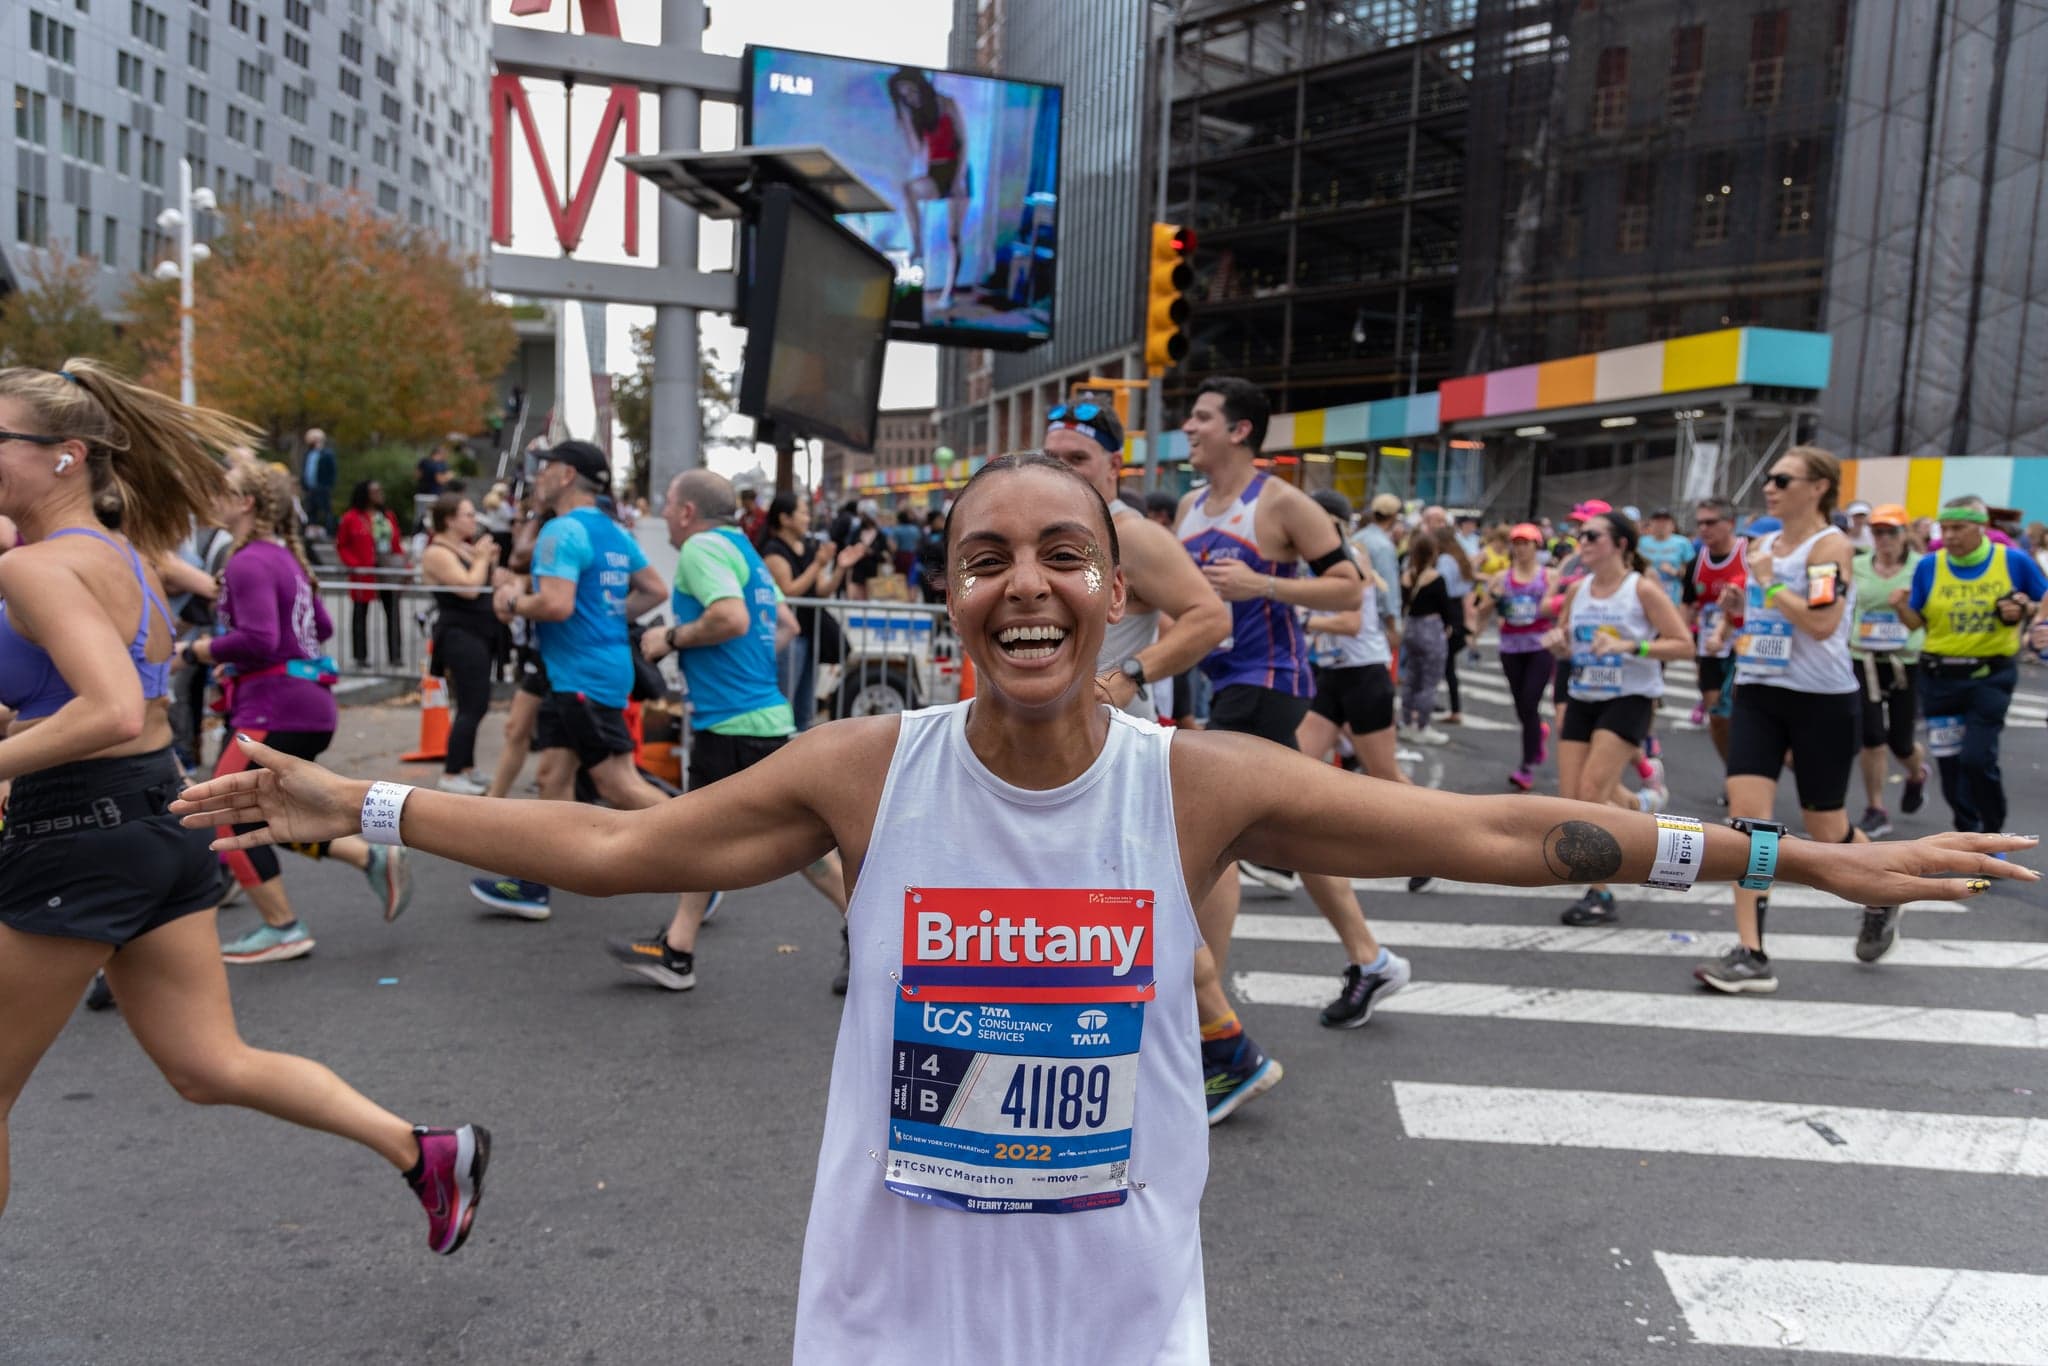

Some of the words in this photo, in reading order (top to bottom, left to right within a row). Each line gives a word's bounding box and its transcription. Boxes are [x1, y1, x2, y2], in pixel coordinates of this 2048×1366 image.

[769, 72, 813, 97] FILM
[917, 910, 1146, 977] Brittany
[922, 1001, 973, 1037] tcs
[979, 1006, 1011, 1018] TATA
[977, 1018, 1053, 1033] CONSULTANCY
[977, 1029, 1025, 1042] SERVICES
[1071, 1032, 1111, 1046] TATA
[921, 1054, 940, 1077] 4
[919, 1089, 939, 1112] B
[1000, 1064, 1110, 1130] 41189
[928, 1139, 943, 1147] YORK
[958, 1144, 990, 1155] MARATHON
[994, 1143, 1052, 1161] 2022
[894, 1159, 1014, 1185] #TCSNYCMarathon
[1047, 1174, 1079, 1183] move
[976, 1200, 1002, 1210] FERRY
[1003, 1201, 1033, 1210] 7:30AM
